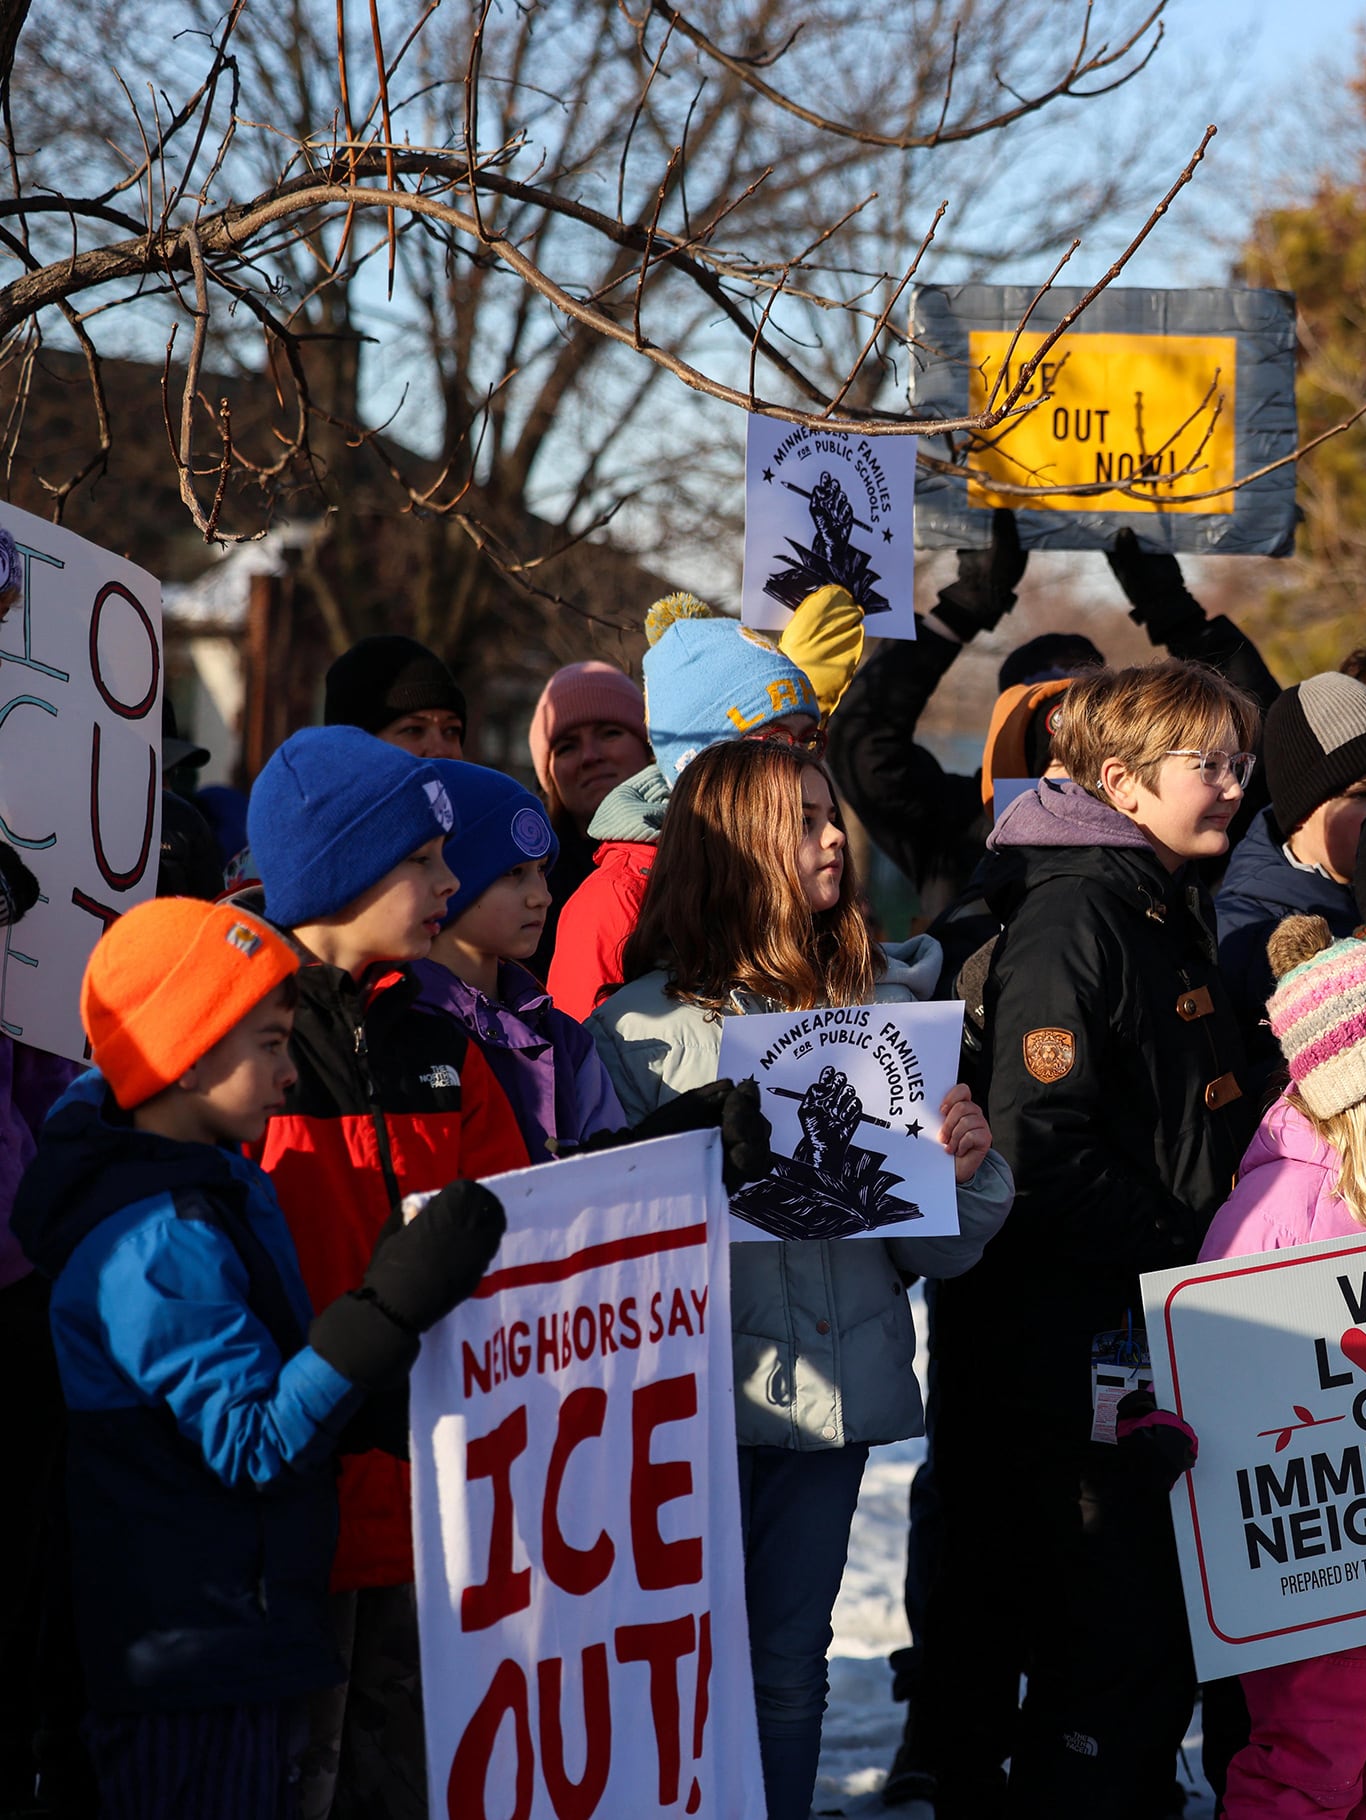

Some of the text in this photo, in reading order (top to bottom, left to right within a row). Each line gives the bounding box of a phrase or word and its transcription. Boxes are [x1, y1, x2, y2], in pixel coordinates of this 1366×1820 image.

[1003, 362, 1056, 395] ICE
[1053, 407, 1110, 443] OUT
[797, 440, 880, 523] FOR PUBLIC SCHOOLS
[857, 440, 892, 513] FAMILIES
[1095, 450, 1177, 489] NOW!
[759, 1009, 925, 1104] MINNEAPOLIS FAMILIES
[792, 1029, 904, 1117] FOR PUBLIC SCHOOLS
[461, 1285, 709, 1399] NEIGHBORS SAY
[461, 1372, 704, 1632] ICE
[1280, 1565, 1342, 1596] PREPARED
[1345, 1560, 1361, 1582] BY
[446, 1610, 712, 1820] OUT!
